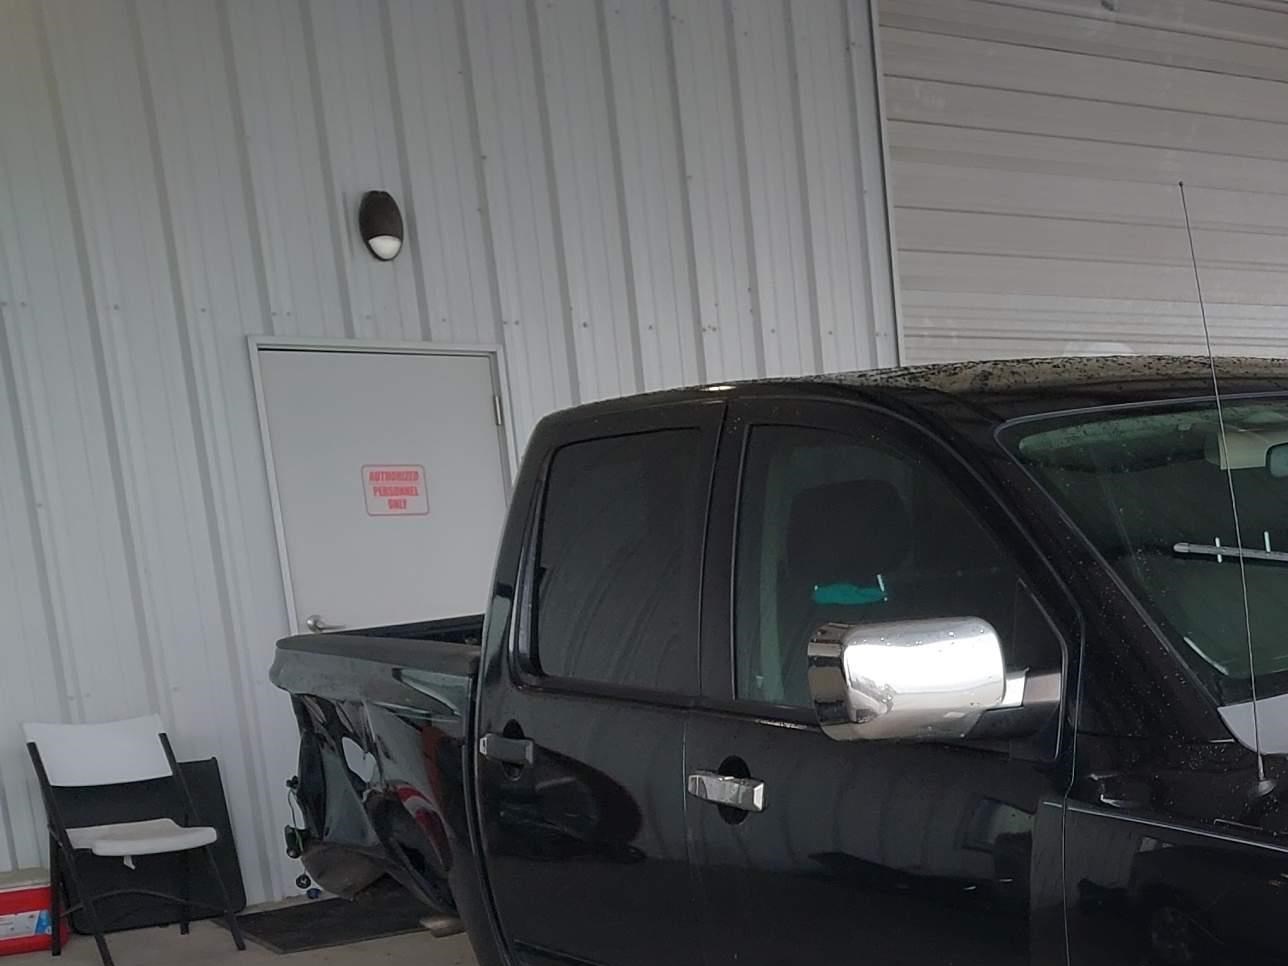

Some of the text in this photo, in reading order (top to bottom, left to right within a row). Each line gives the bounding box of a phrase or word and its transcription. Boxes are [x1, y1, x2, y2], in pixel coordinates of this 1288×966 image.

[369, 471, 419, 481] AUTHORIZED
[373, 486, 419, 497] PERSONNEL
[388, 499, 407, 509] ONLY
